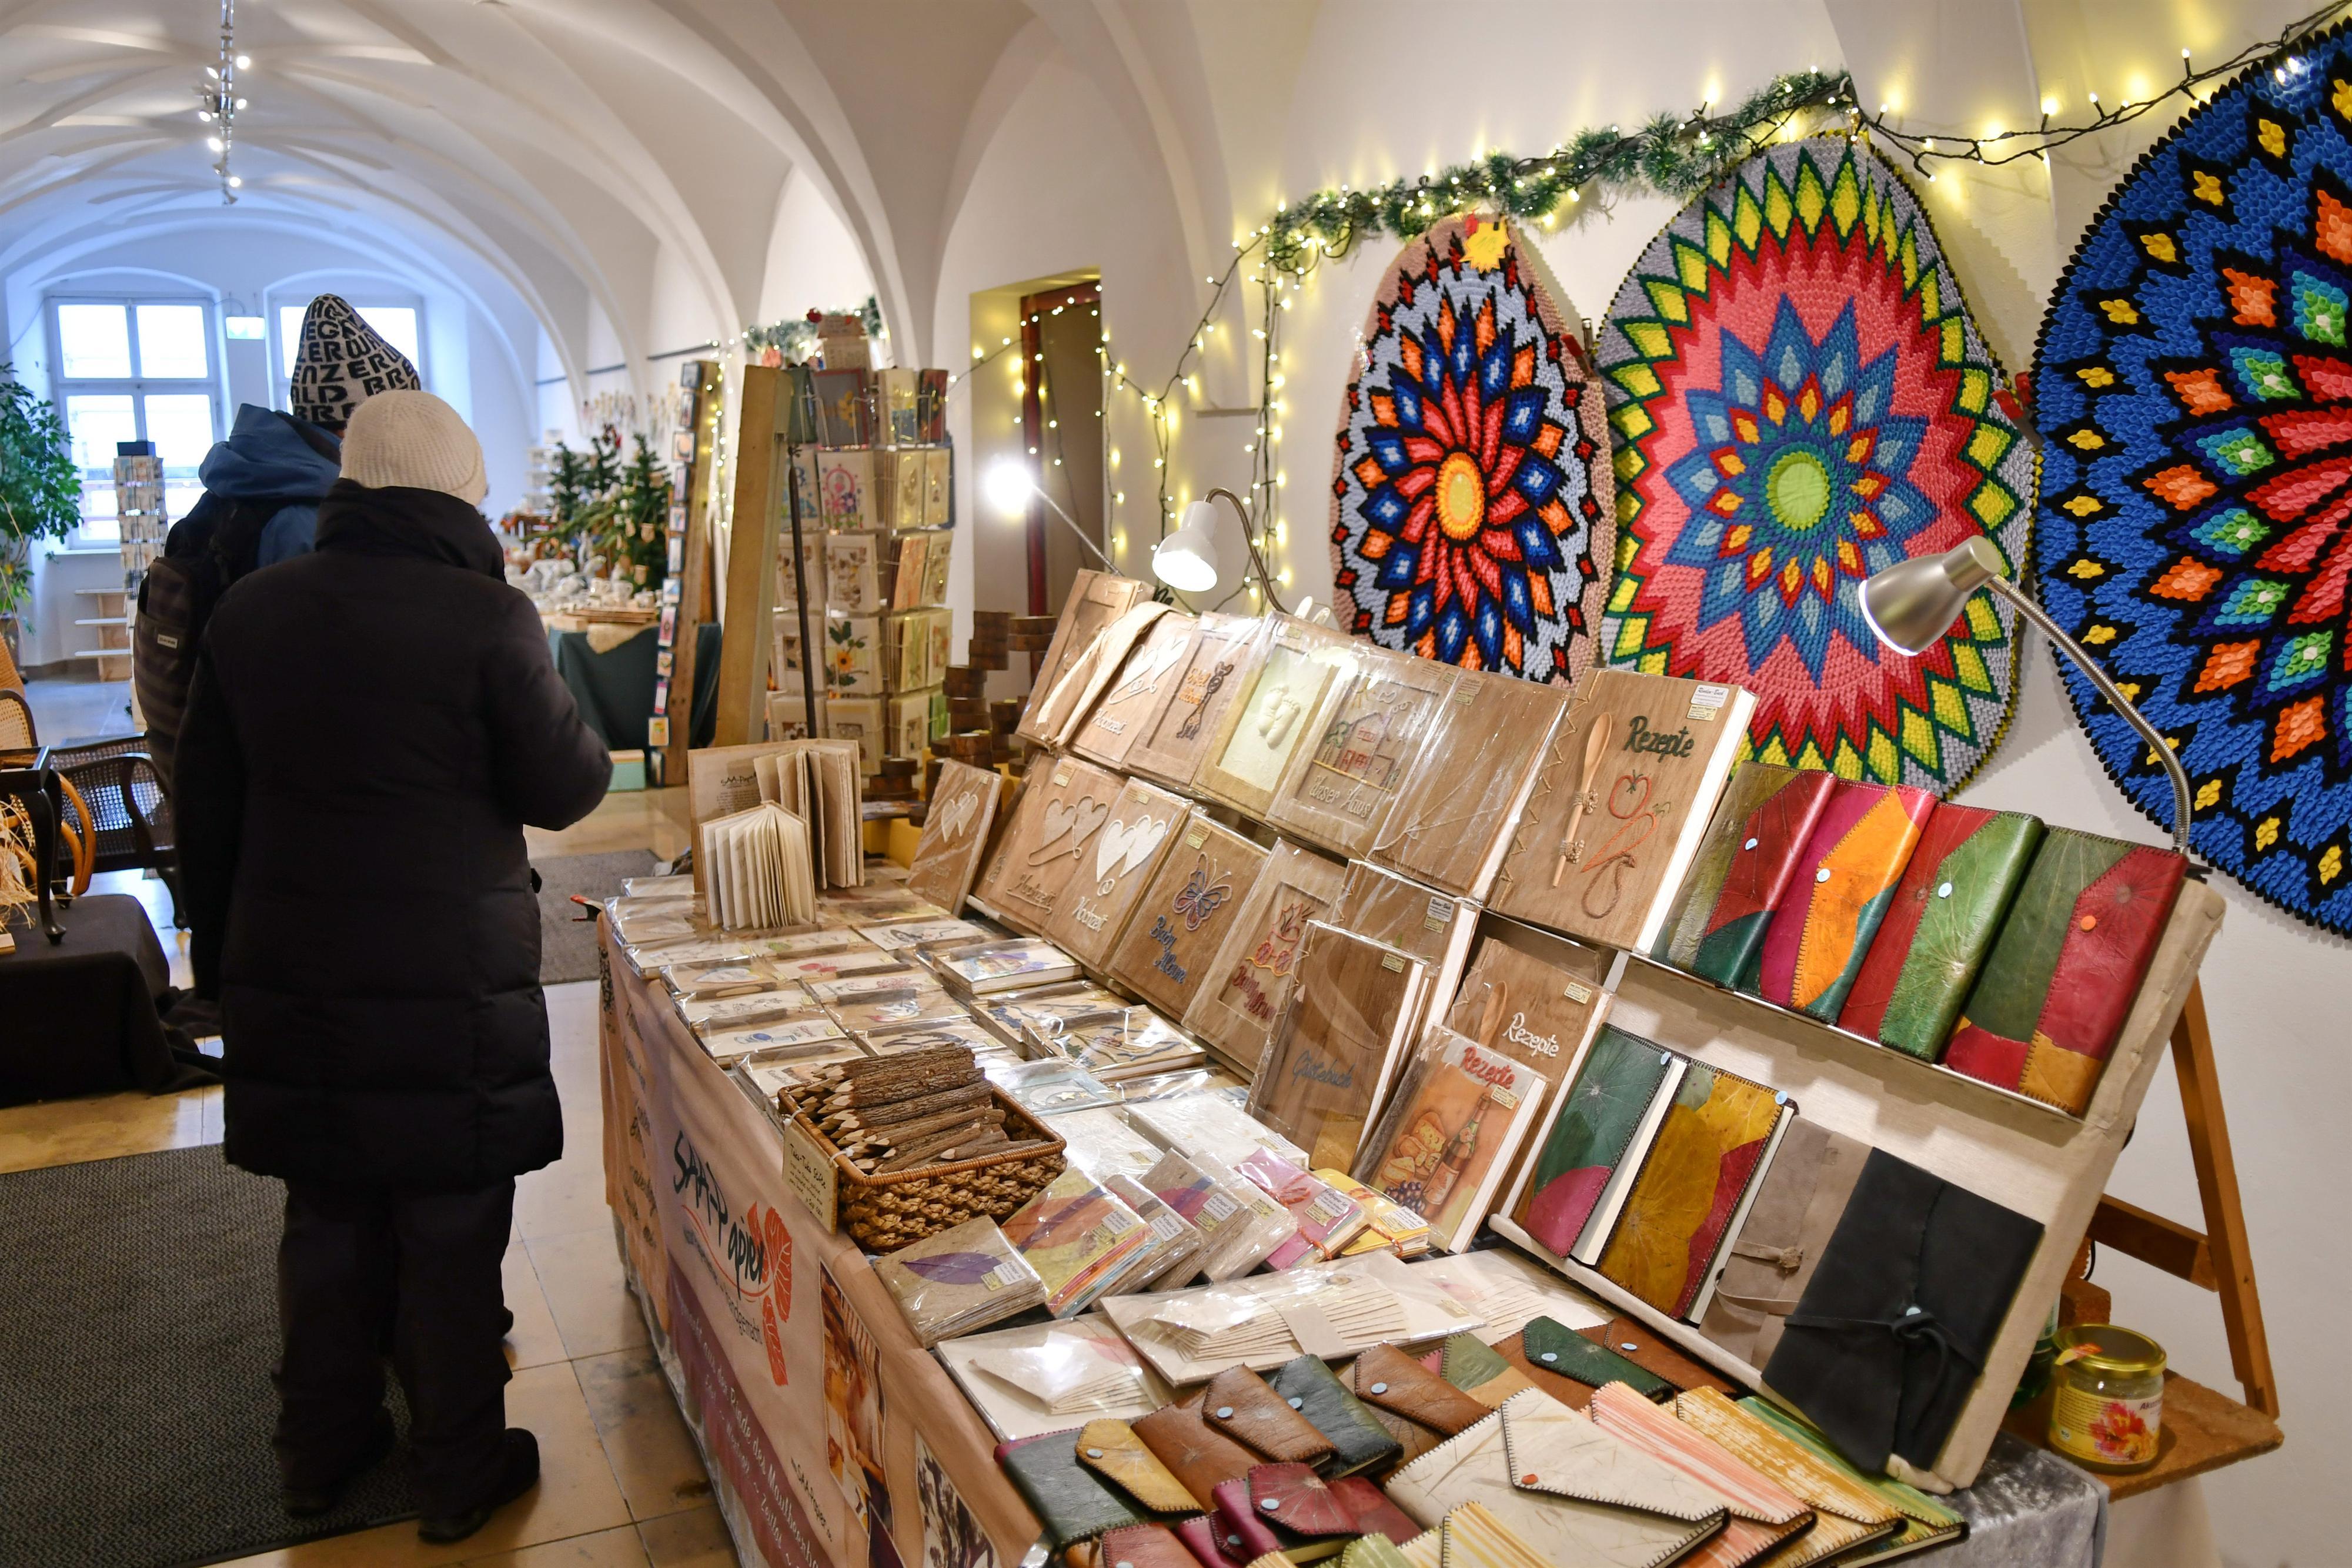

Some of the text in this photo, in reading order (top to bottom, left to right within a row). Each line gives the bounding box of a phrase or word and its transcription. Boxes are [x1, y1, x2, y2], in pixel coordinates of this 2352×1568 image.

[1623, 715, 1695, 763] Rezepte
[1309, 775, 1371, 818] Unser Haus
[1073, 897, 1108, 932] Hochzeit
[1150, 915, 1177, 952] Baby
[1153, 950, 1187, 984] Album
[1232, 965, 1259, 999] Baby
[1502, 1012, 1559, 1057] Rezepte
[1459, 1046, 1516, 1090] Rezepte
